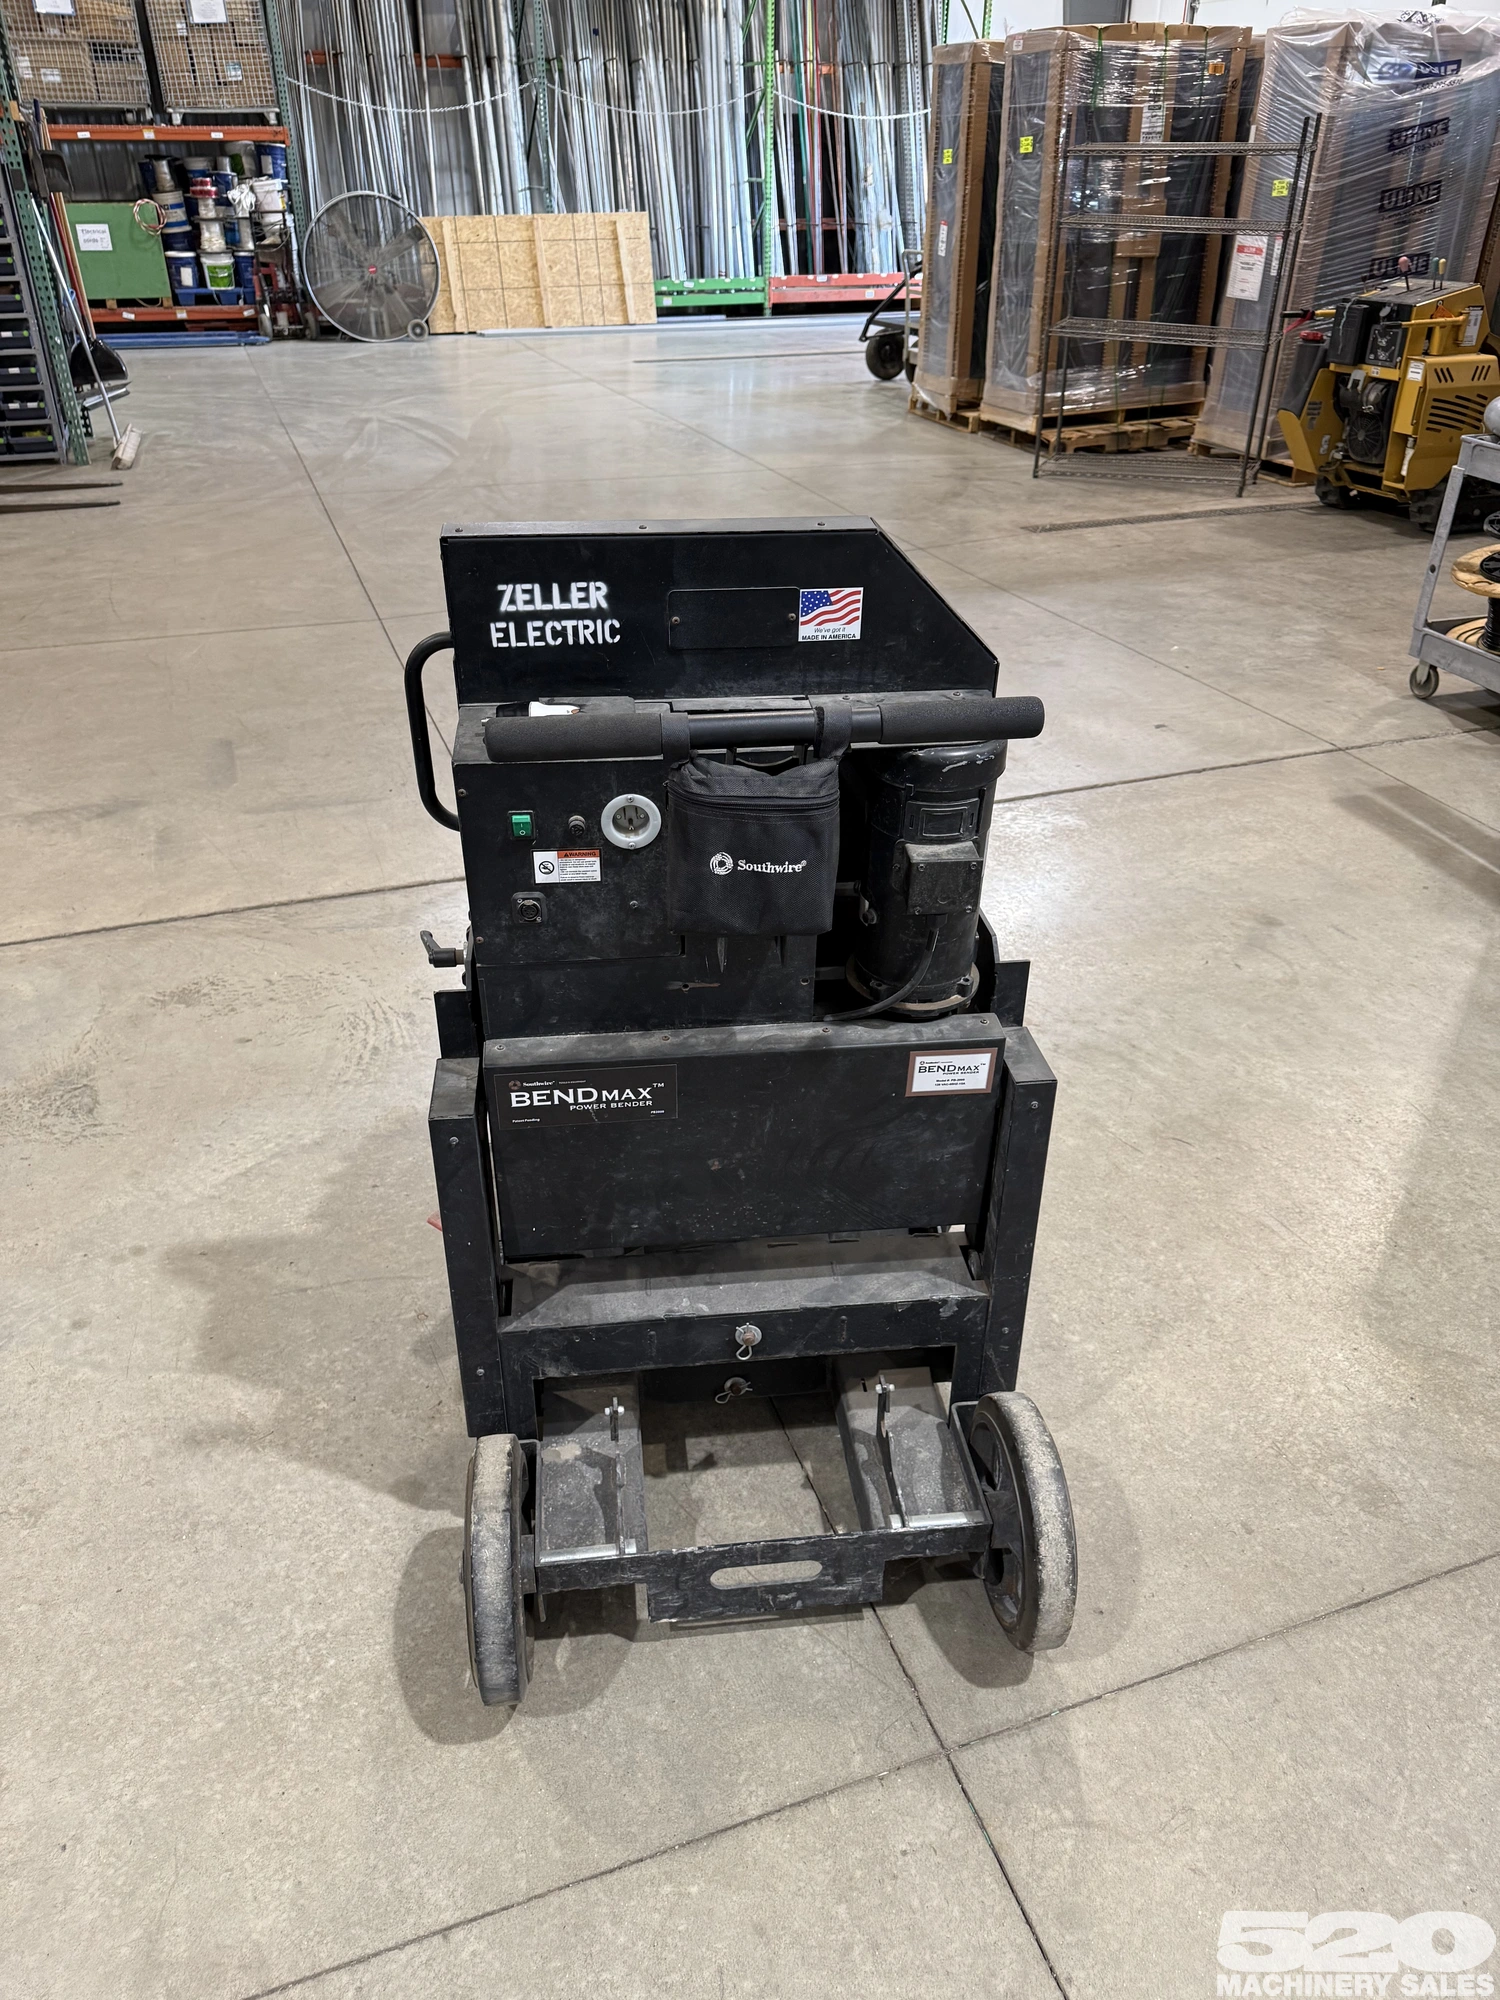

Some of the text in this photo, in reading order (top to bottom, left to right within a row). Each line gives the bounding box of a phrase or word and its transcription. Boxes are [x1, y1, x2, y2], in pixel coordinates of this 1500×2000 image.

[1381, 182, 1440, 211] ULINE
[1372, 254, 1429, 278] ULNE
[497, 581, 608, 611] ZELLER
[489, 619, 620, 648] ELECTRIC
[570, 1101, 653, 1111] POWER BENDER
